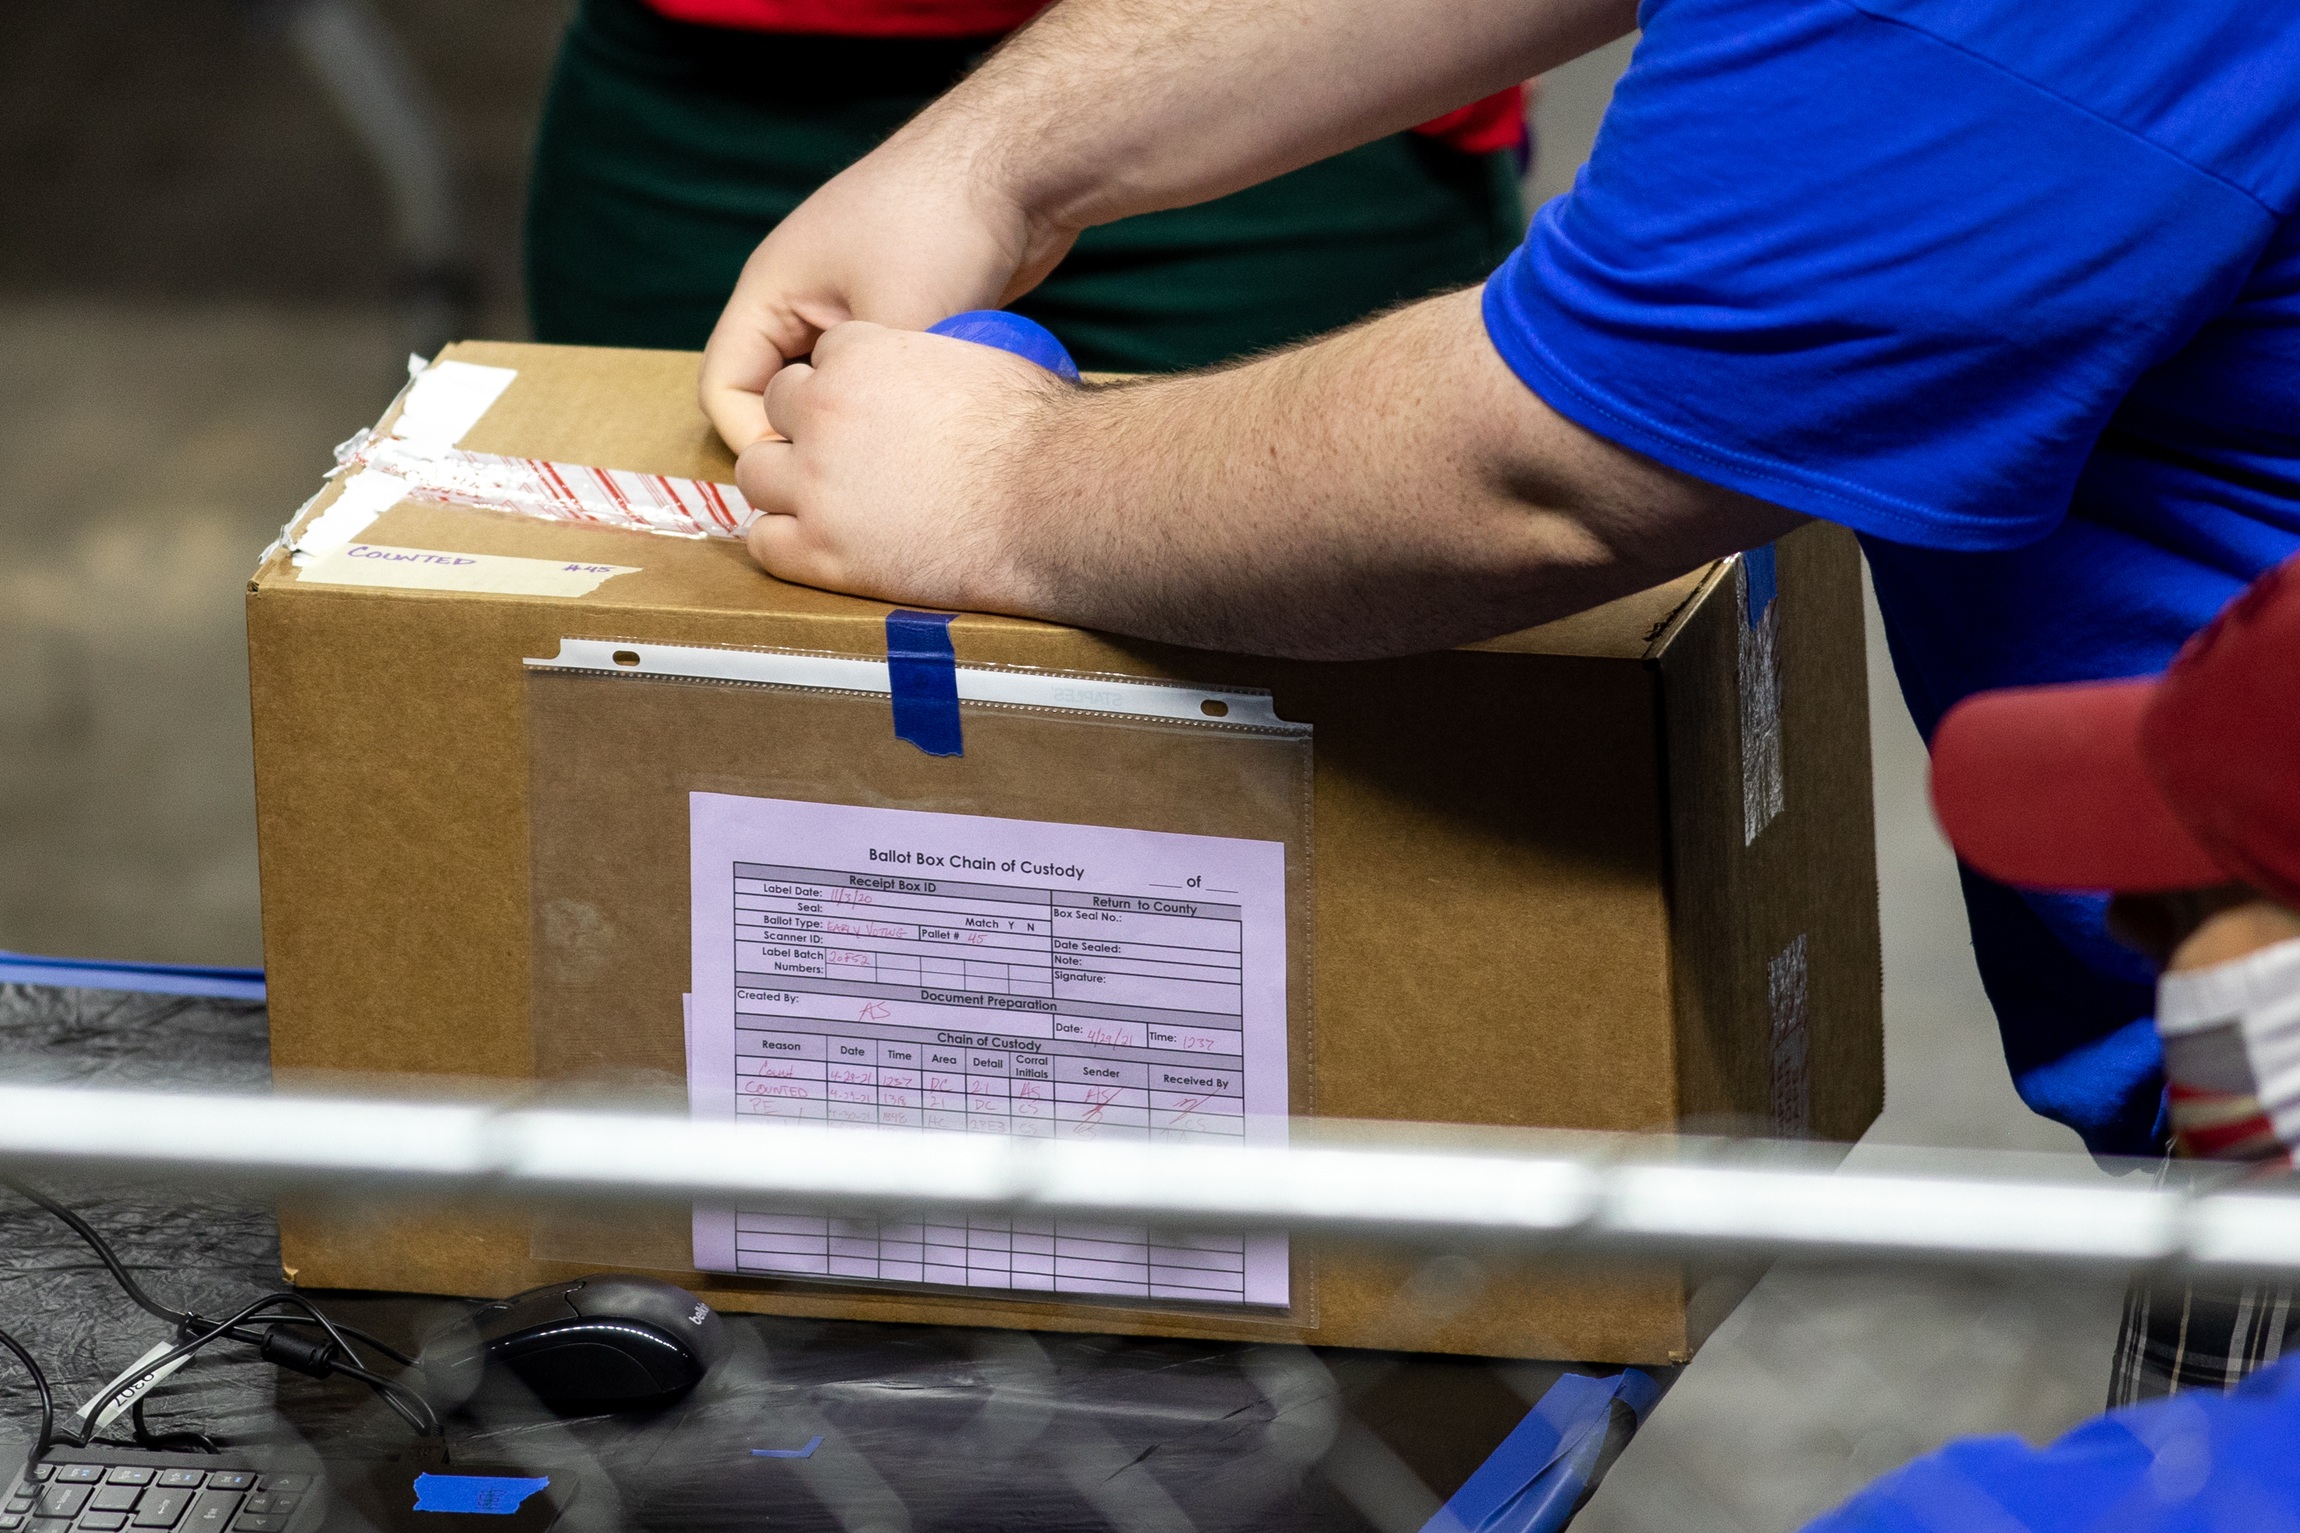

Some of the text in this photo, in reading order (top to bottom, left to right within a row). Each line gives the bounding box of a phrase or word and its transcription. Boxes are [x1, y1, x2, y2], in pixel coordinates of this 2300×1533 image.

[347, 545, 613, 574] COUNTED #45
[869, 849, 1084, 880] Ballot Box Chain of Custody
[849, 875, 936, 892] Receipt Box ID
[1186, 876, 1202, 888] of
[764, 884, 822, 897] Label Date:
[798, 903, 822, 913] Seal:
[1093, 897, 1197, 917] Return to County
[1054, 909, 1122, 922] Box Seal No.:
[764, 915, 822, 930] Ballot Type:
[965, 917, 1034, 931] Match Y N
[764, 931, 823, 943] Scanner ID:
[922, 929, 960, 940] Pallet #
[968, 934, 988, 944] 45
[1054, 940, 1121, 953] Date Sealed:
[762, 947, 824, 960] Label Batch
[1054, 956, 1082, 966] Note:
[774, 962, 824, 974] Numbers:
[1054, 971, 1106, 983] Signature:
[737, 990, 799, 1004] Created By:
[921, 991, 1057, 1011] Document Preparation
[858, 1001, 891, 1022] AS
[1056, 1024, 1083, 1034] Date:
[938, 1033, 1042, 1052] Chain of Custody
[1150, 1032, 1177, 1042] Time:
[762, 1041, 801, 1050] Reason
[840, 1047, 865, 1056] Date
[888, 1051, 912, 1060] Time
[931, 1055, 957, 1064] Area
[1016, 1056, 1048, 1066] Corral
[973, 1058, 1003, 1068] Detail
[1016, 1068, 1048, 1078] Initials
[1083, 1067, 1120, 1078] Sender
[930, 1078, 952, 1094] DC
[1164, 1075, 1228, 1089] Received By
[745, 1081, 808, 1098] COUNTED
[975, 1099, 997, 1111] DC
